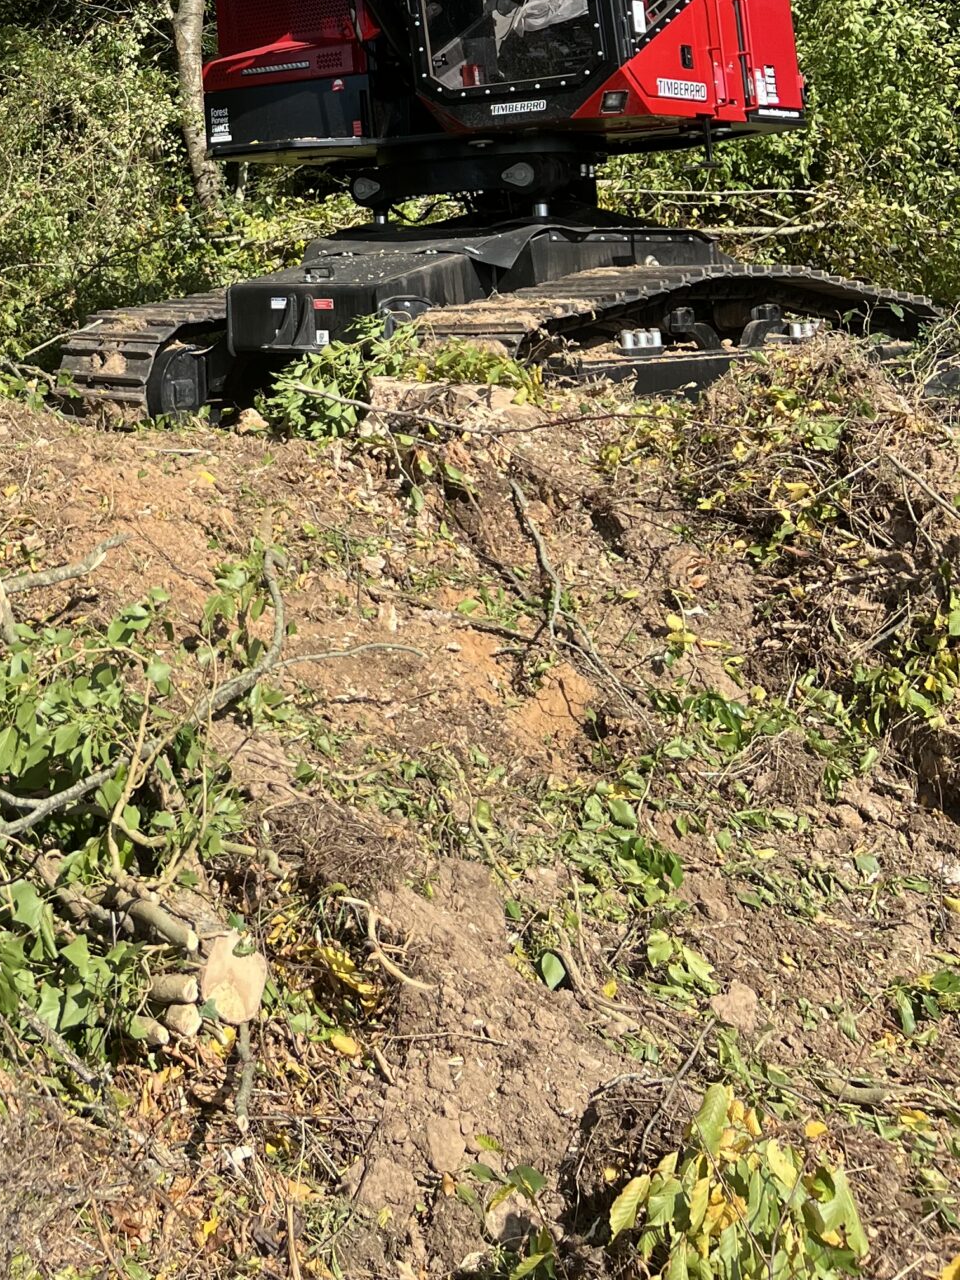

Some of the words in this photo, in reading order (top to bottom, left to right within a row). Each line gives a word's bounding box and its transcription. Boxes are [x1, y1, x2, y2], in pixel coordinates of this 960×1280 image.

[658, 79, 706, 99] TIMBERPRO
[211, 108, 228, 117] Forest
[491, 100, 545, 114] TIMBERPRO
